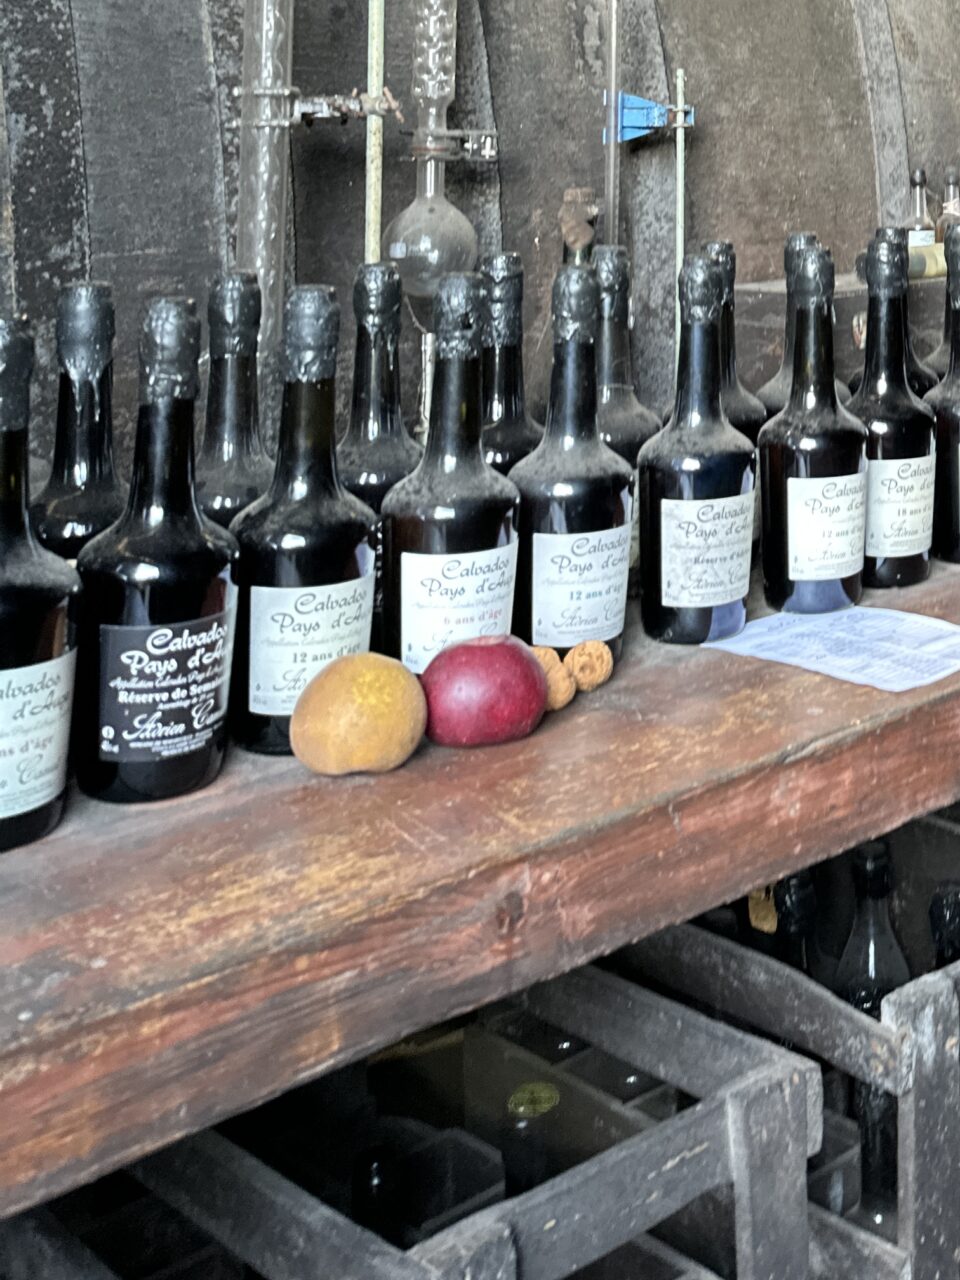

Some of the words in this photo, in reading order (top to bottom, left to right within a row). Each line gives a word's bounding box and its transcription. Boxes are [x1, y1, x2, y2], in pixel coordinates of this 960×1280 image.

[897, 461, 933, 480] Calvad
[821, 481, 865, 500] Calvad
[880, 478, 915, 496] Pays
[696, 503, 751, 524] Calvado
[804, 498, 841, 518] Pays
[677, 520, 718, 542] Pays
[441, 555, 511, 581] Calvados
[550, 554, 593, 577] Pays
[419, 577, 467, 601] Pays
[475, 570, 515, 595] d'Aug
[569, 590, 583, 601] 12
[584, 590, 603, 600] ans
[294, 588, 368, 616] Calvados
[270, 611, 321, 638] Pays
[454, 615, 475, 626] ans
[120, 649, 179, 677] Pays
[292, 651, 308, 664] 12
[311, 652, 333, 663] ans
[0, 671, 62, 701] alvados
[118, 689, 170, 704] Réserve
[171, 687, 188, 701] de
[121, 710, 187, 740] Adrien
